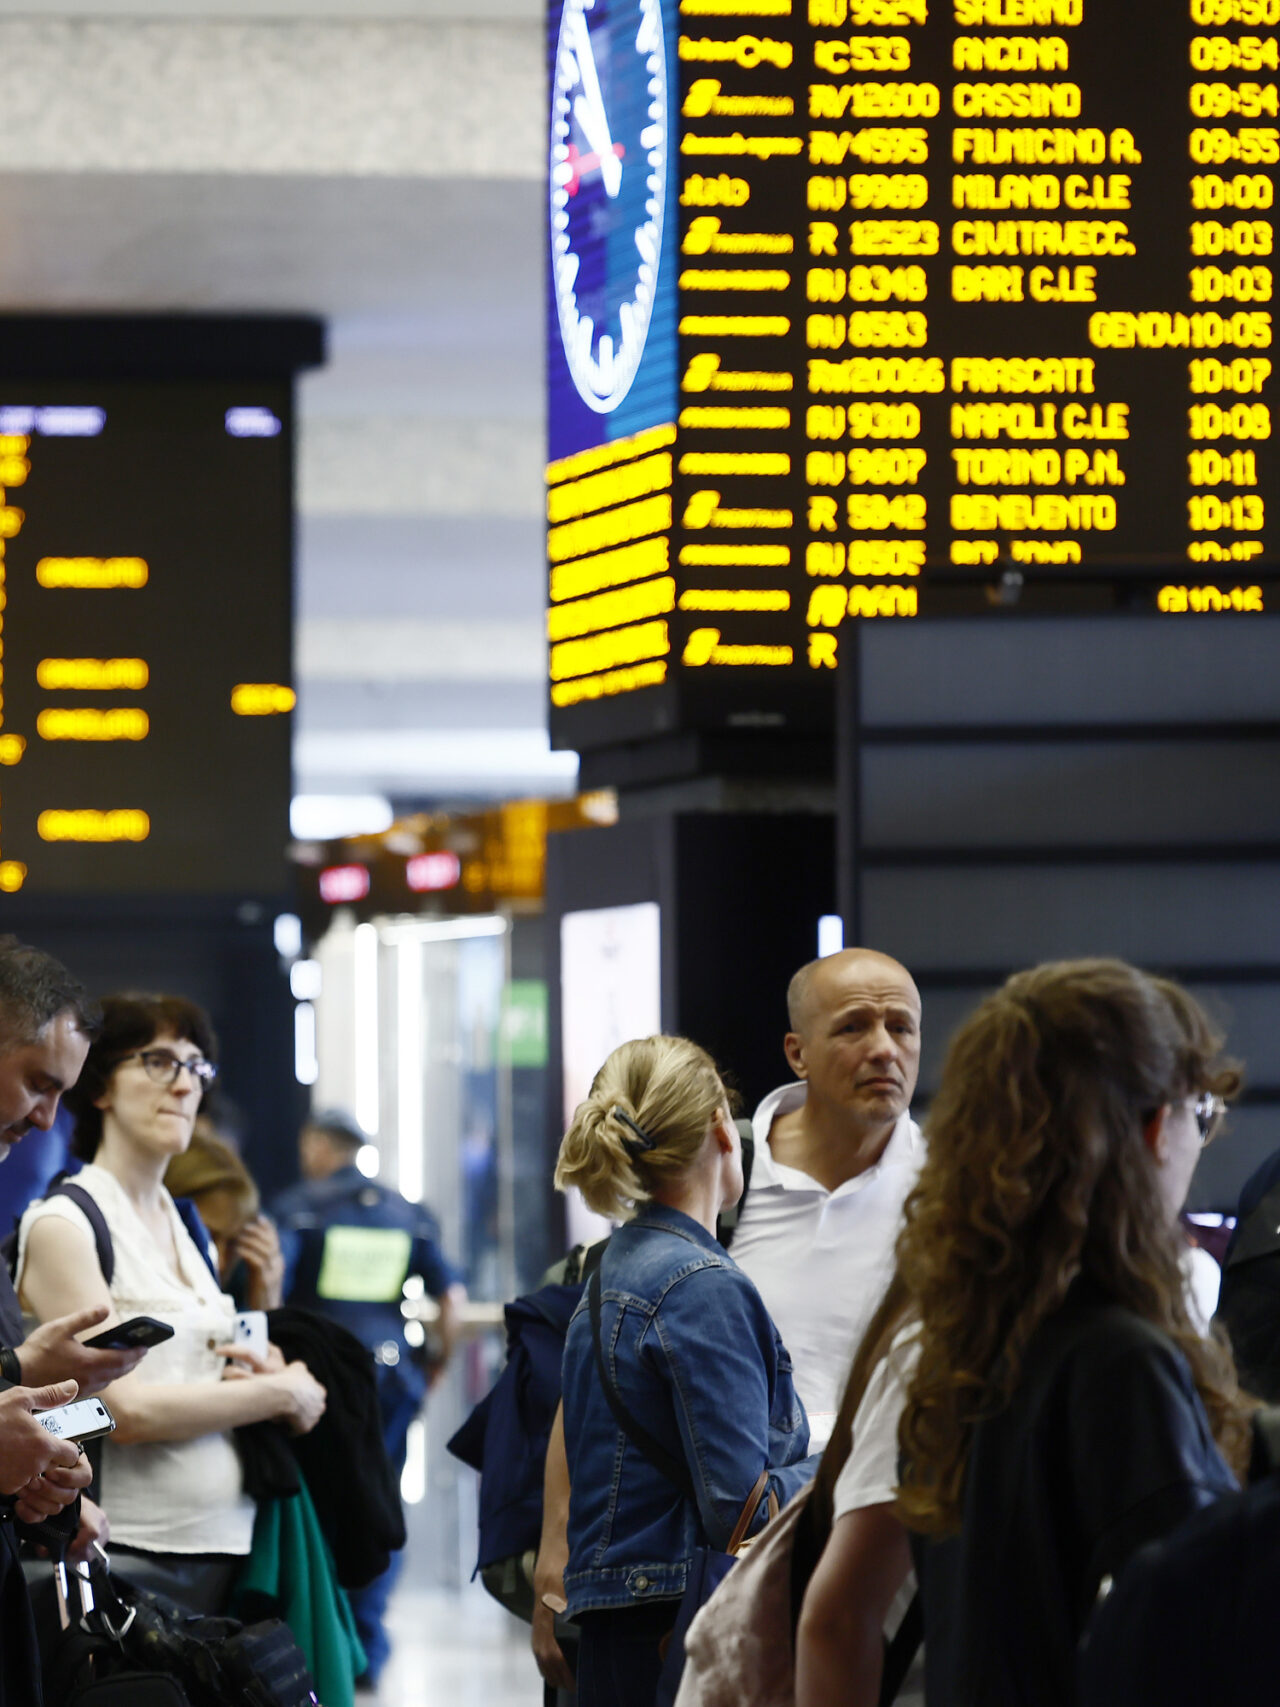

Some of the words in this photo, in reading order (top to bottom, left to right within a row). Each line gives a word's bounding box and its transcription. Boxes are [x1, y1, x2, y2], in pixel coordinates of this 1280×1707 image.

[954, 0, 1082, 25] SALERNO
[1191, 0, 1280, 25] 09:50
[849, 37, 910, 70] 533
[954, 37, 1068, 70] ANCONA
[1191, 37, 1280, 70] 09:54
[953, 83, 1081, 117] CASSINO
[1190, 83, 1279, 117] 09:54
[953, 128, 1105, 163] FIUMICINO
[1190, 128, 1280, 163] 09:55
[953, 175, 1060, 209] MILANO
[1191, 175, 1273, 209] 10:00
[809, 222, 838, 254] R
[952, 221, 1136, 255] CIVITAVECC.
[1191, 221, 1272, 255] 10:03
[952, 266, 1024, 301] BARI
[1190, 266, 1272, 301] 10:03
[1189, 312, 1271, 347] 10:05
[952, 358, 1094, 393] FRASCATI
[1190, 358, 1271, 393] 10:07
[951, 403, 1056, 439] NAPOLI
[1189, 403, 1271, 439] 10:08
[953, 449, 1060, 485] TORINO
[1065, 449, 1125, 485] P.N.
[1189, 449, 1256, 485] 10:11
[808, 496, 837, 530] R
[951, 495, 1116, 530] BENEVENTO
[1189, 495, 1263, 530] 10:13
[809, 633, 837, 667] R
